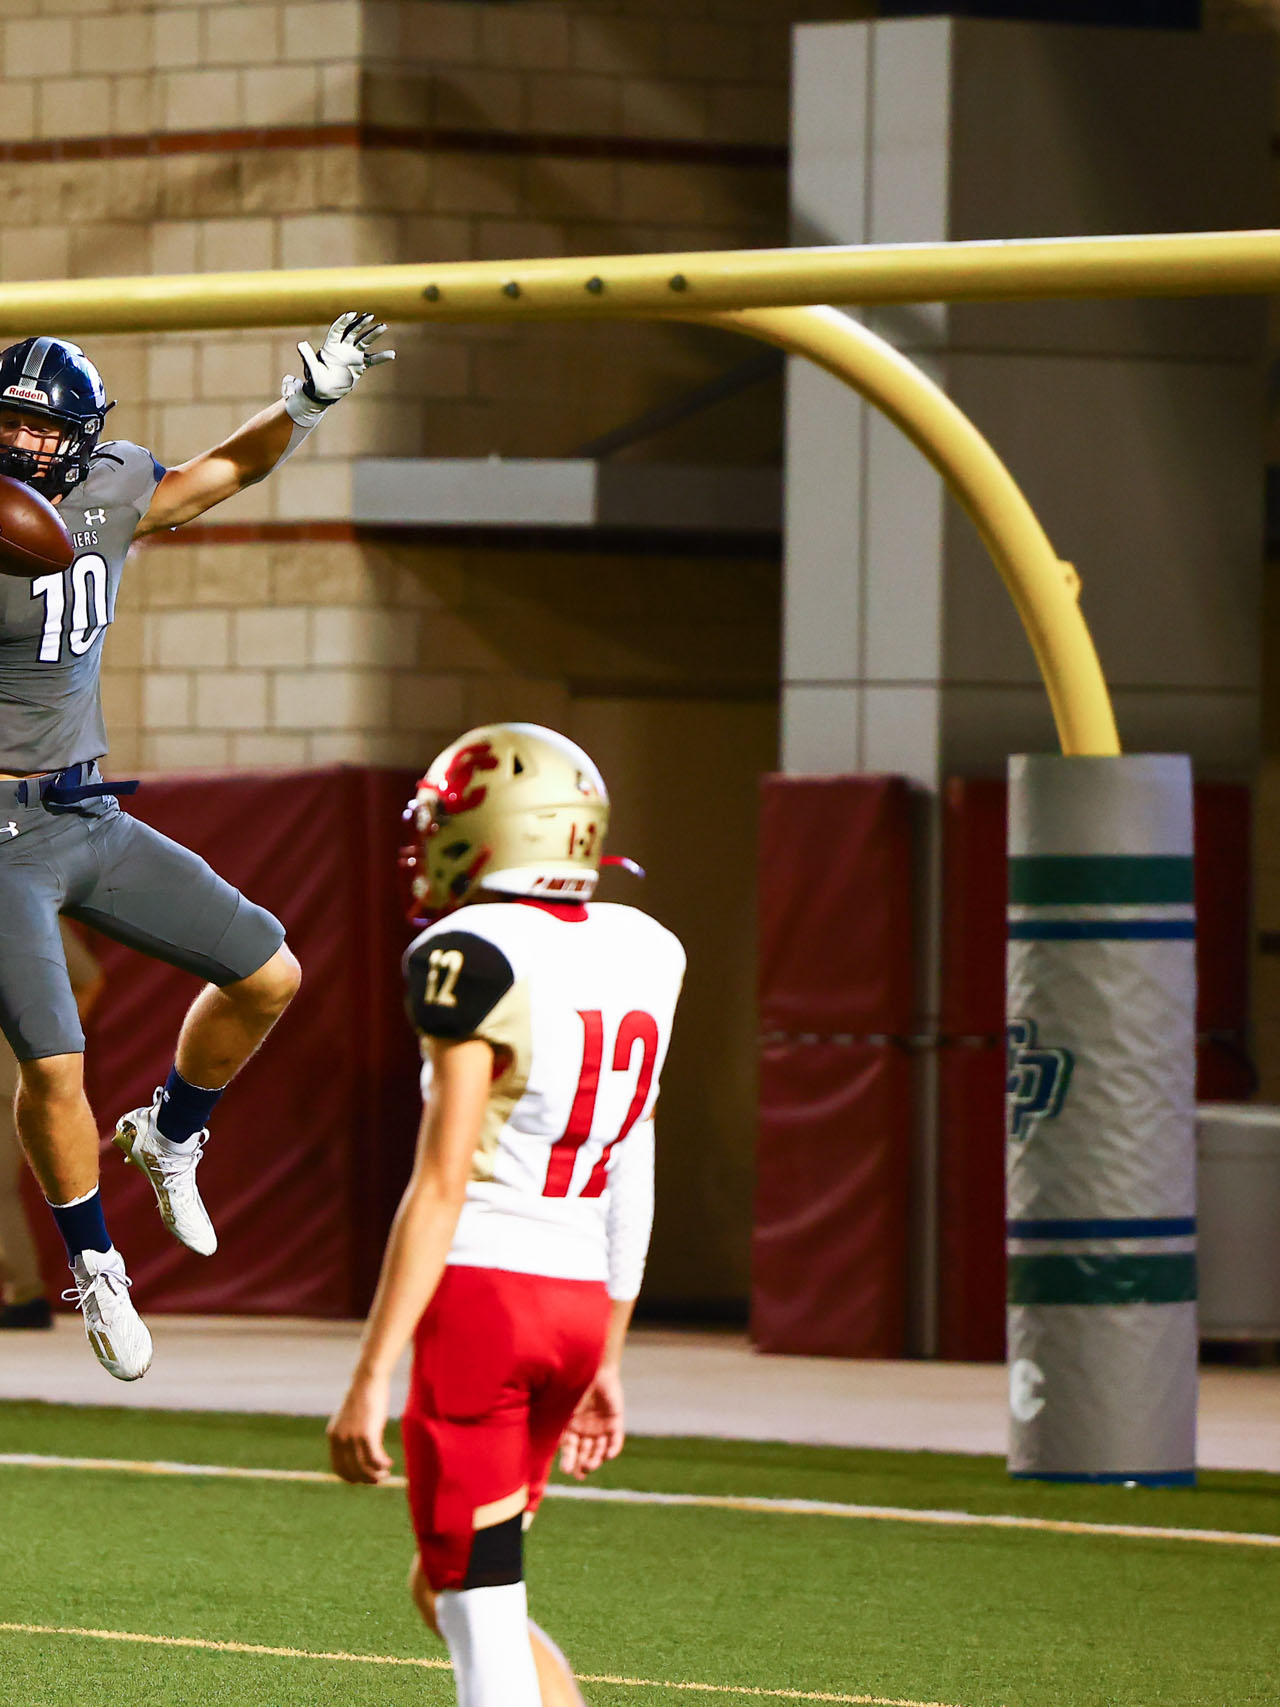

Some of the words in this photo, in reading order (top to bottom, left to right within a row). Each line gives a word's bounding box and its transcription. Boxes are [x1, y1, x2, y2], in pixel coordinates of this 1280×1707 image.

[8, 386, 44, 401] Riddell
[70, 530, 98, 549] IERS
[30, 552, 108, 664] 10
[423, 948, 464, 1008] 12
[540, 1008, 659, 1199] 12
